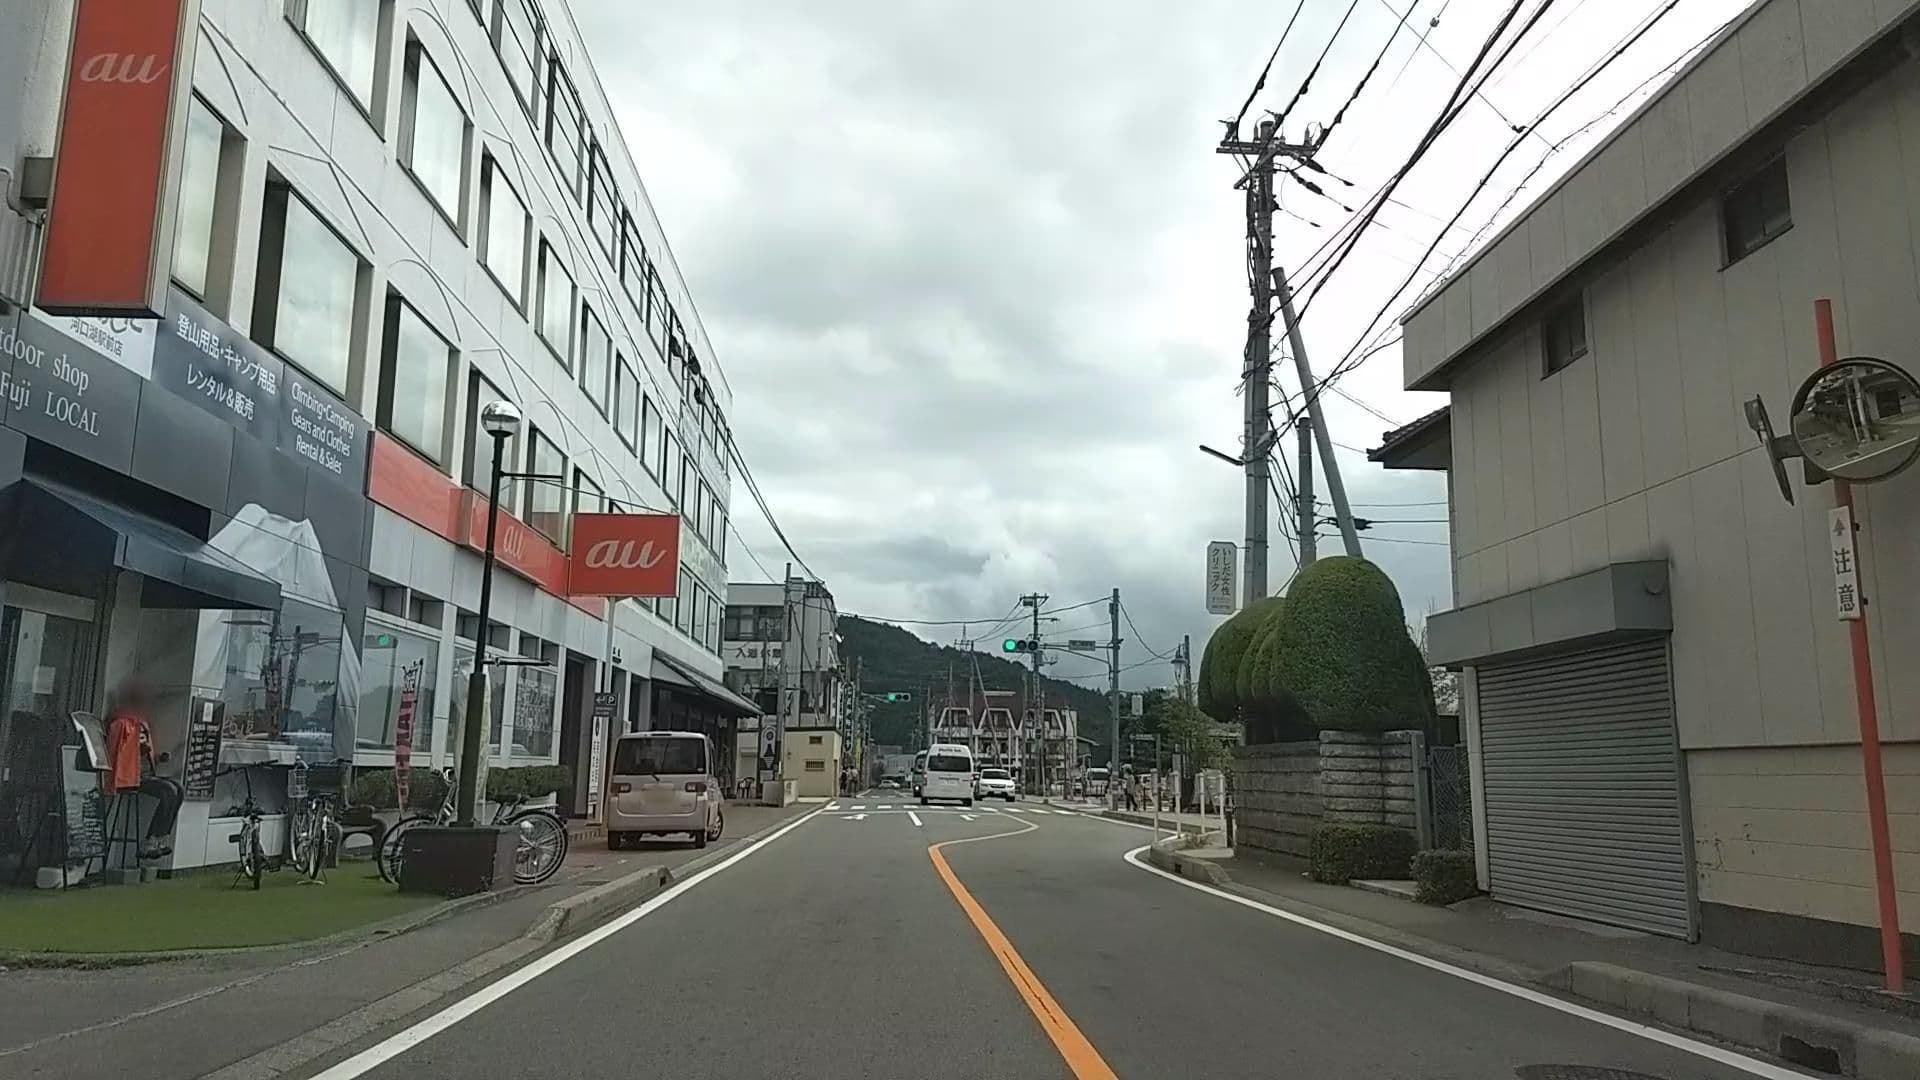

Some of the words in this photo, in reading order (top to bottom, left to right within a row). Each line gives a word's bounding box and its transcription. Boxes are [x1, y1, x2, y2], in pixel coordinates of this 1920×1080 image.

[80, 52, 168, 83] au
[52, 354, 89, 396] shop
[0, 371, 31, 410] Fuji
[45, 391, 99, 436] LOCAL
[291, 408, 312, 434] Gears
[312, 425, 326, 443] and
[326, 429, 351, 457] Clothes
[295, 434, 319, 462] Rental
[318, 447, 325, 465] &
[325, 451, 342, 474] Sales
[503, 526, 526, 560] au
[585, 540, 668, 568] au
[1834, 547, 1855, 612] 注意
